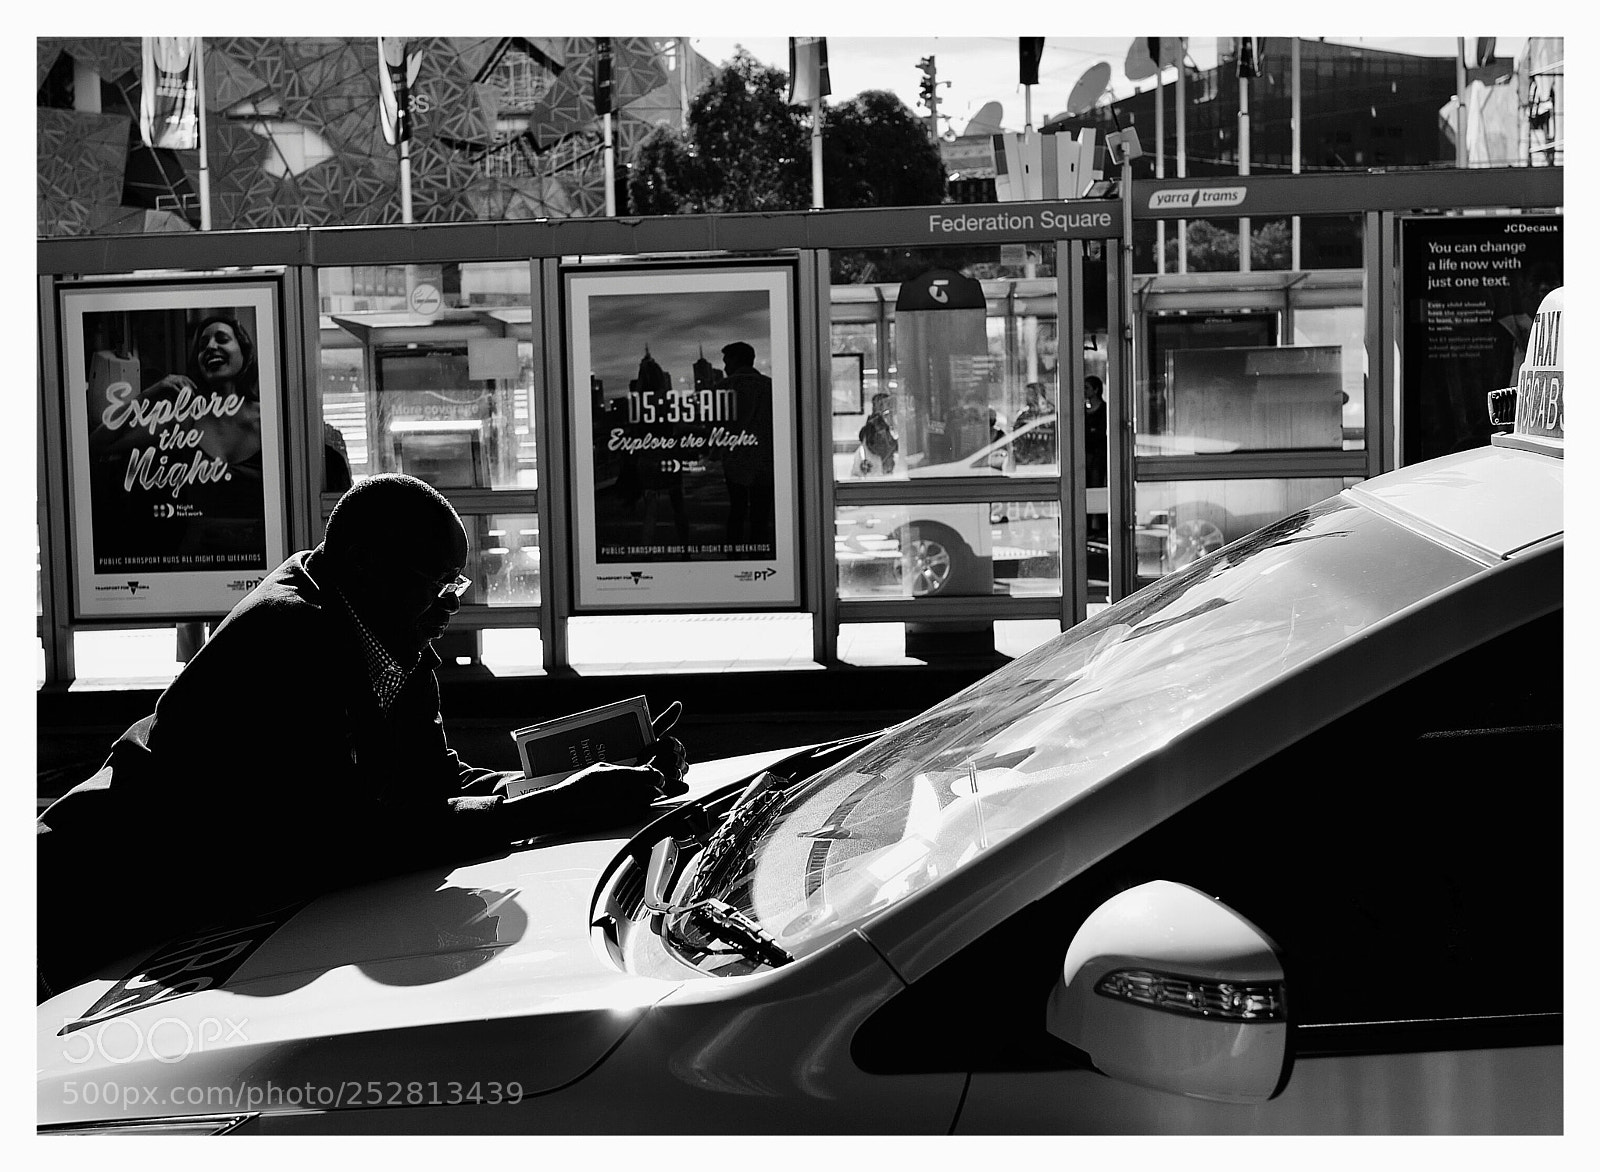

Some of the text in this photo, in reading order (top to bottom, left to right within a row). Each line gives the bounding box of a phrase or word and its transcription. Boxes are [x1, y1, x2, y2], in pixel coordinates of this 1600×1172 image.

[1157, 191, 1238, 206] yarra trams
[929, 210, 1111, 232] Federation Square
[1504, 223, 1558, 233] JCDecaux
[1428, 240, 1526, 254] You can change
[1428, 257, 1521, 270] a life now with
[1428, 276, 1510, 290] just one text.
[1532, 311, 1562, 366] TAXI
[102, 382, 244, 435] Explore
[159, 424, 205, 450] the
[608, 427, 758, 455] Explore the Night.
[124, 446, 232, 498] Night.
[601, 547, 625, 555] PUBLIC
[627, 546, 665, 554] TRANSPORT
[667, 545, 685, 554] RUNS
[688, 545, 699, 553] ALL
[723, 544, 733, 552] ON
[735, 544, 770, 552] WEEKENDS
[99, 557, 122, 565] PUBLIC
[124, 556, 160, 564] TRANSPORT
[162, 556, 179, 564] RUNS
[195, 555, 214, 563] NIGHT
[227, 554, 261, 562] WEEKENDS
